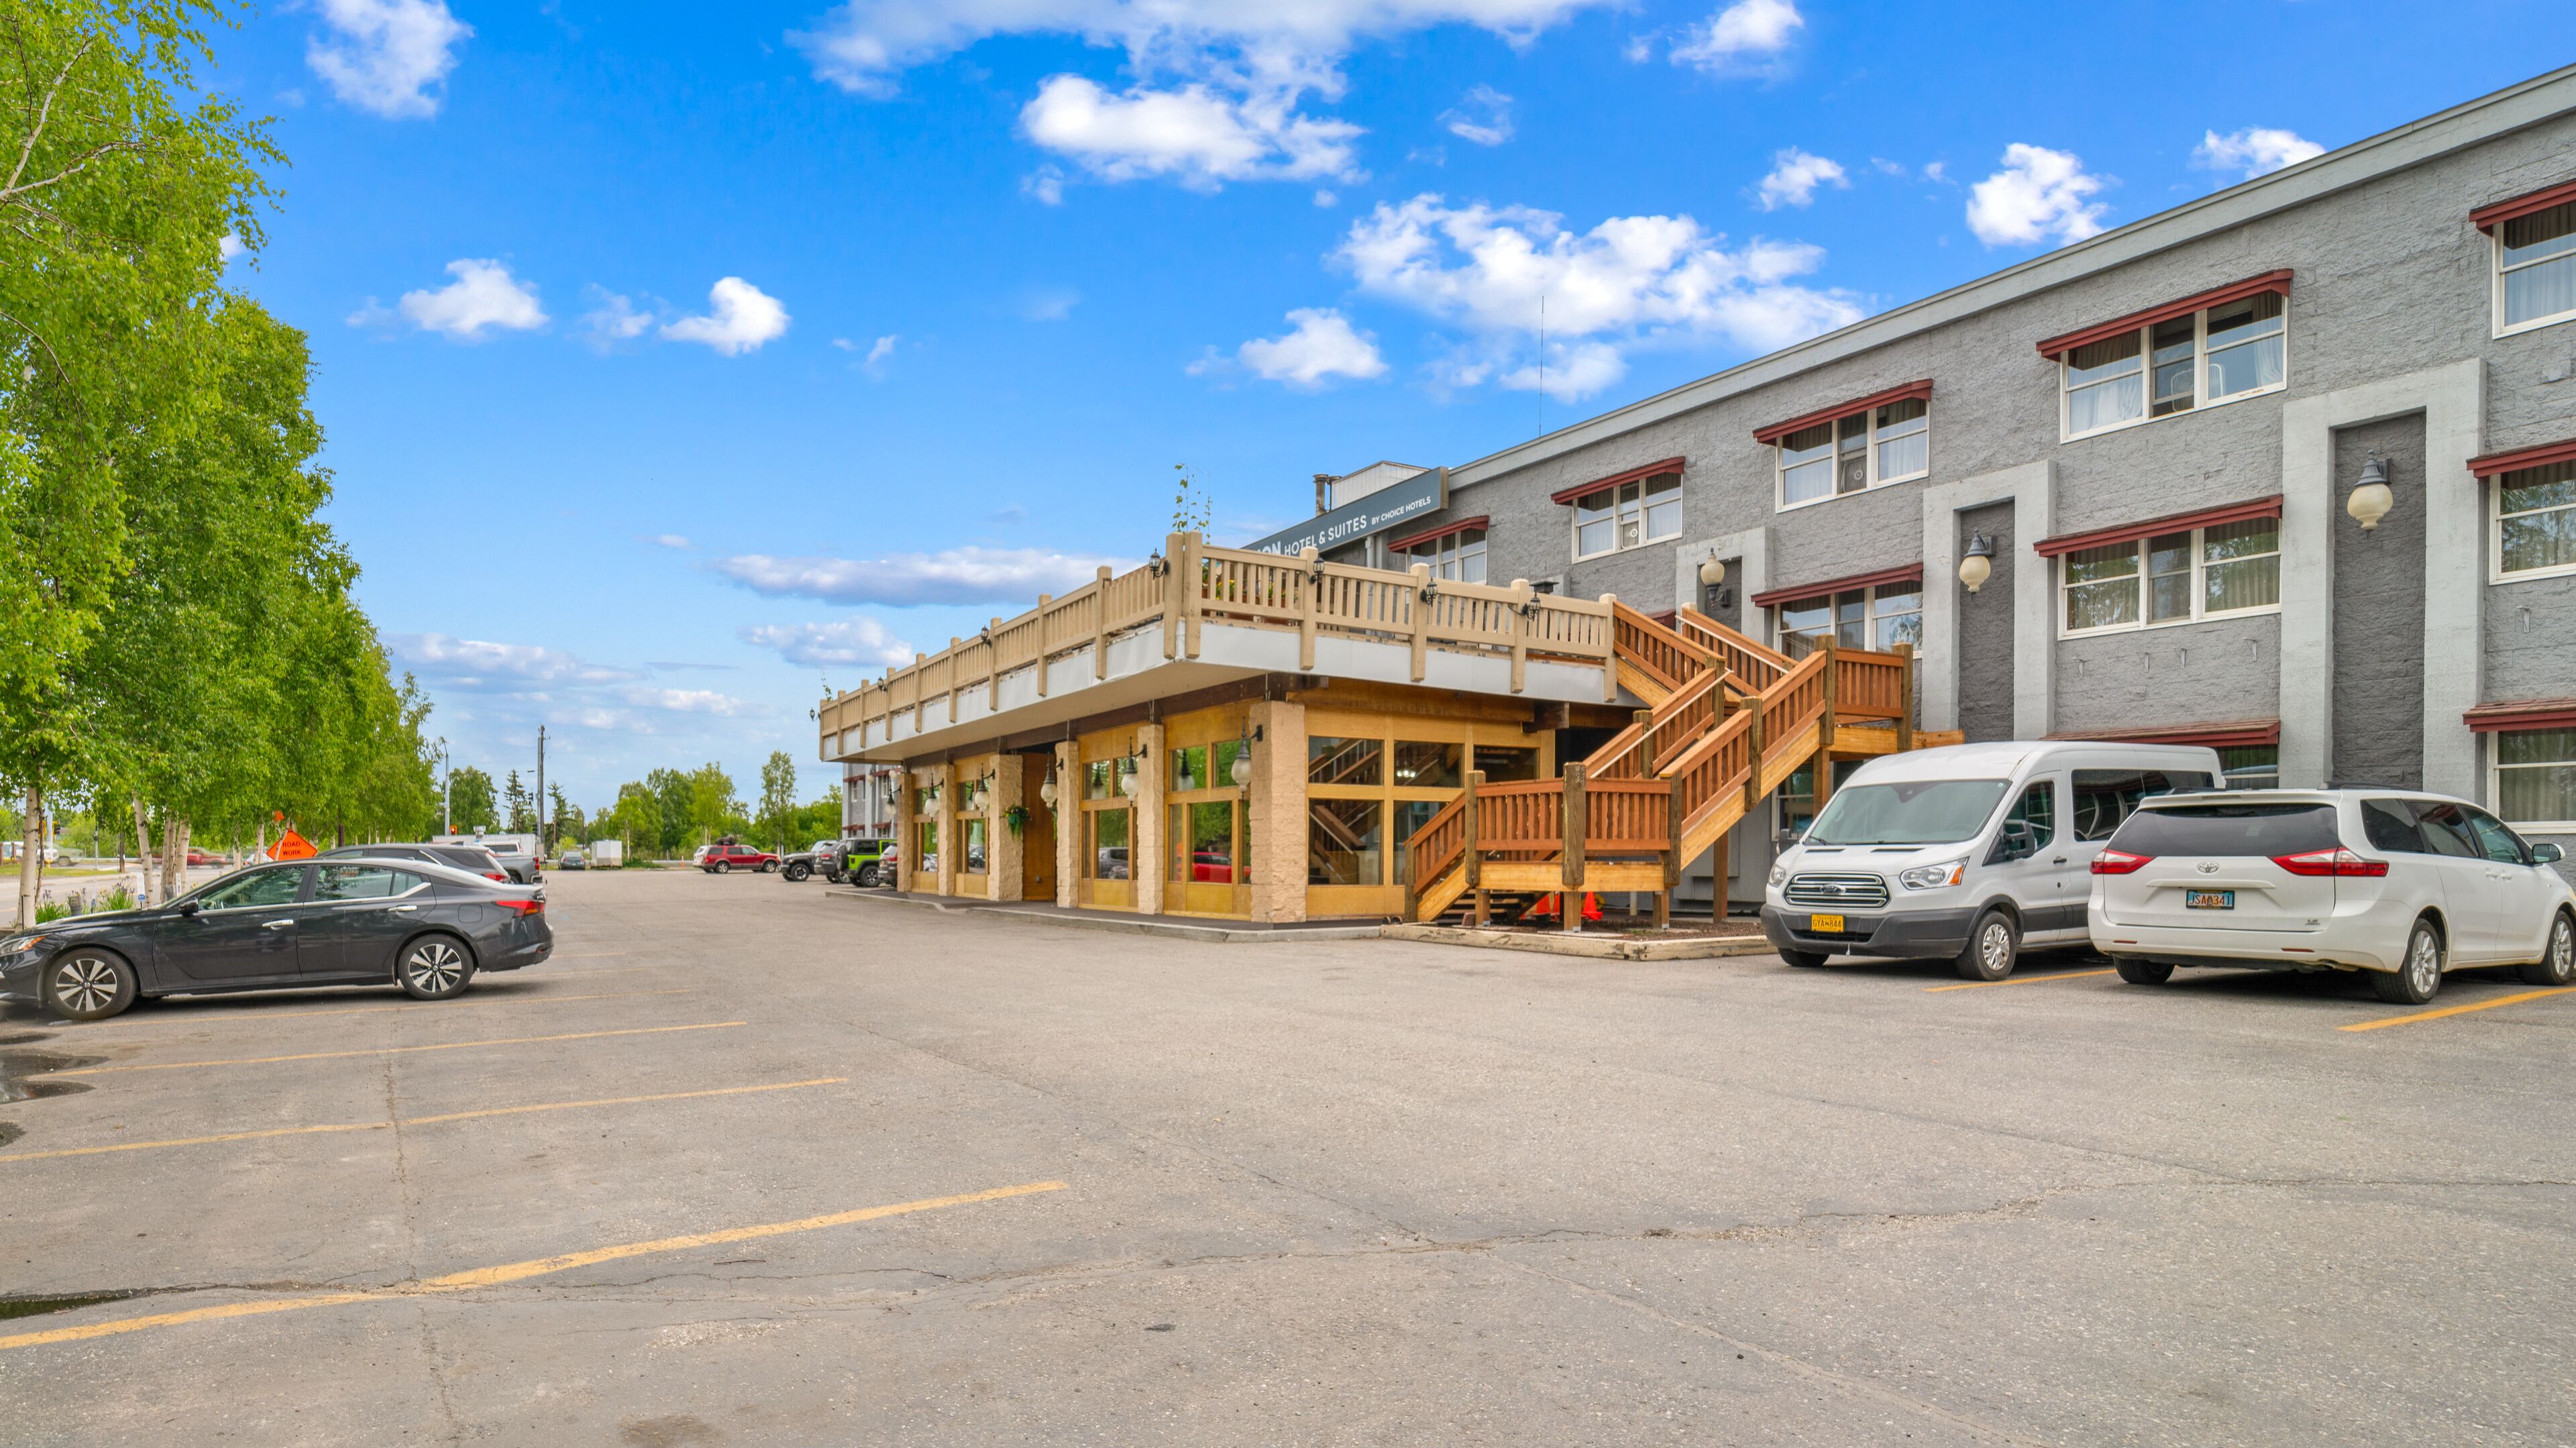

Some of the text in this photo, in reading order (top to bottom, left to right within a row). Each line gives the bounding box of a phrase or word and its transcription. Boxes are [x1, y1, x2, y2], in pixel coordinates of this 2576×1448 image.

[1284, 535, 1317, 556] HOTEL
[1319, 531, 1326, 544] &
[1328, 514, 1367, 541] SUITES
[1371, 515, 1380, 525] BY
[1381, 506, 1405, 521] CHOICE
[1405, 496, 1431, 512] HOTELS
[2213, 895, 2230, 905] 341
